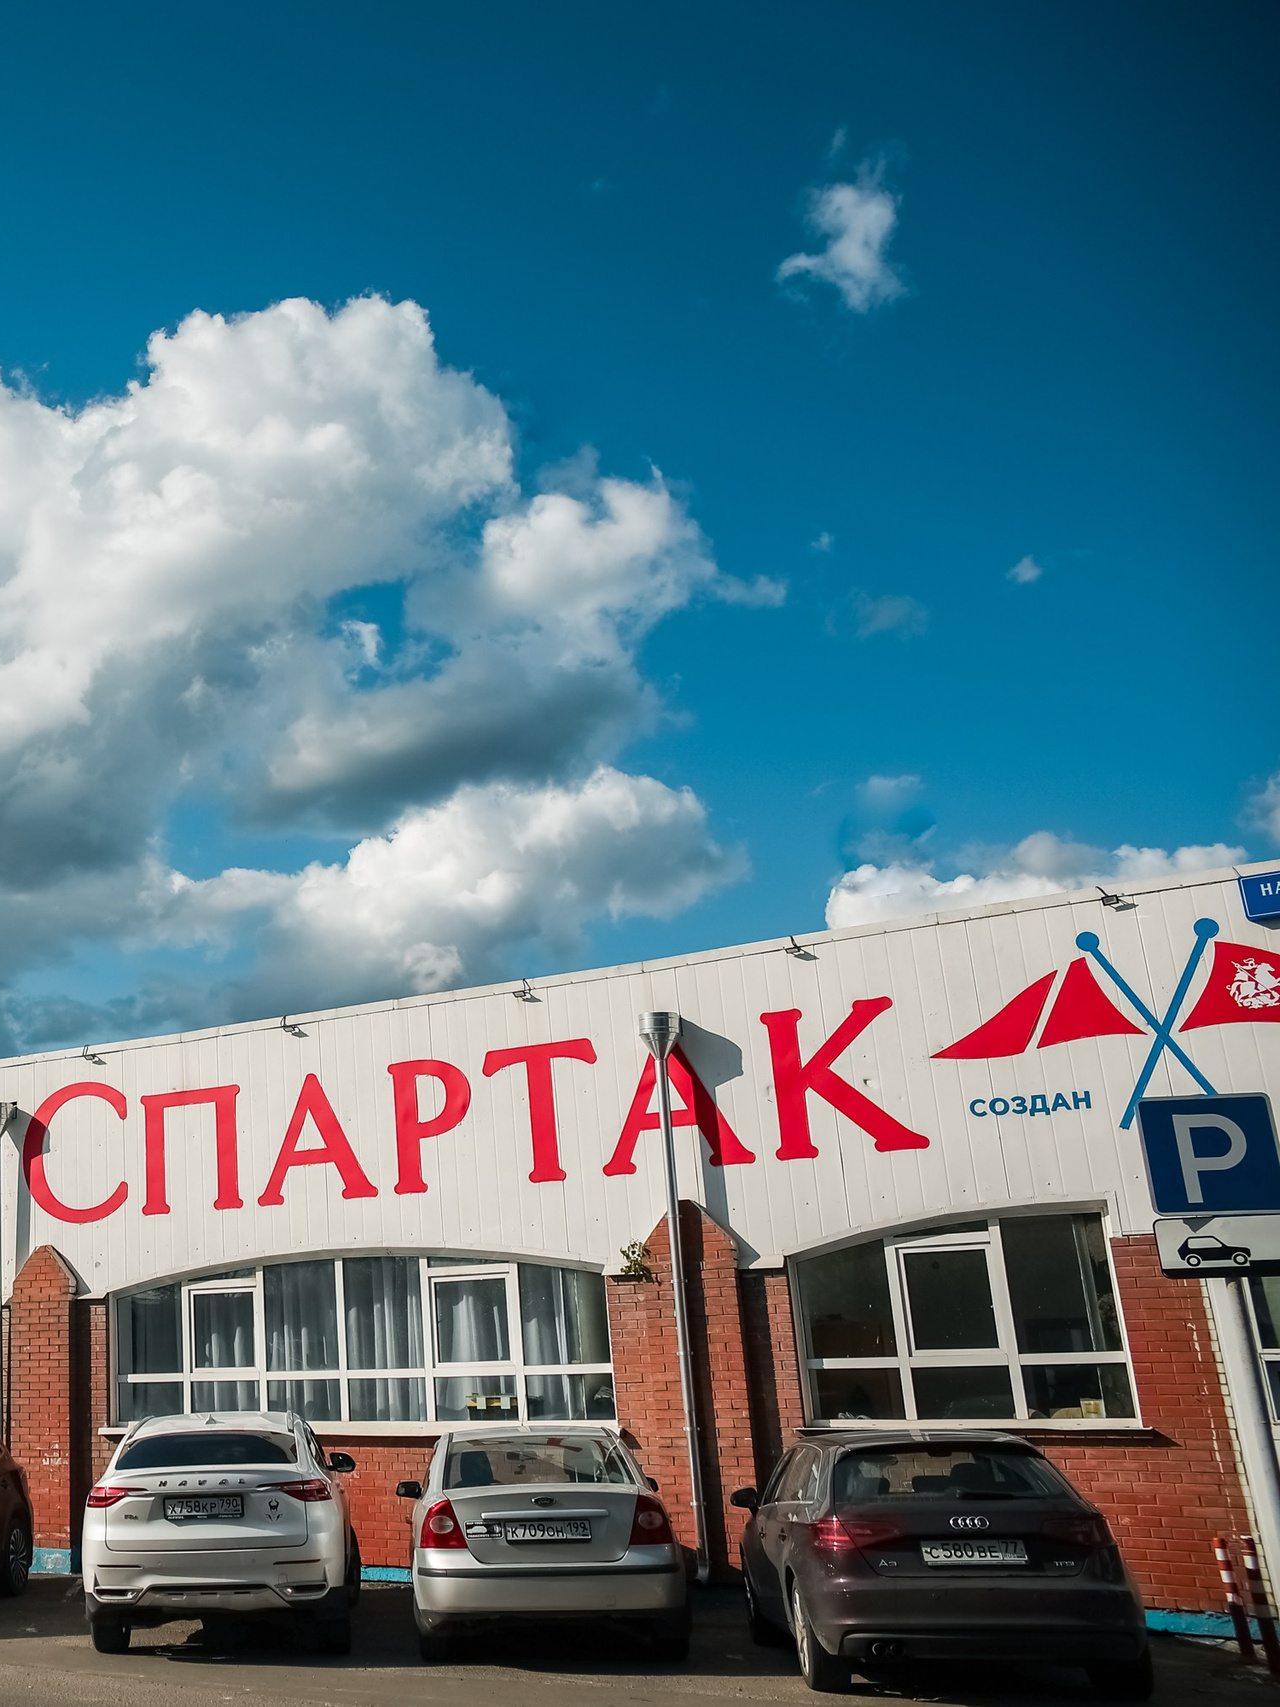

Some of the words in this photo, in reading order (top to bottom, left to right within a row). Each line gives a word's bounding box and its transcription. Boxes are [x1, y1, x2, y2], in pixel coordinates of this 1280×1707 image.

[23, 996, 931, 1225] СПАРТАК
[969, 1091, 1093, 1117] СОЗДАН
[1171, 1113, 1248, 1204] P
[158, 1478, 247, 1488] HAVAL
